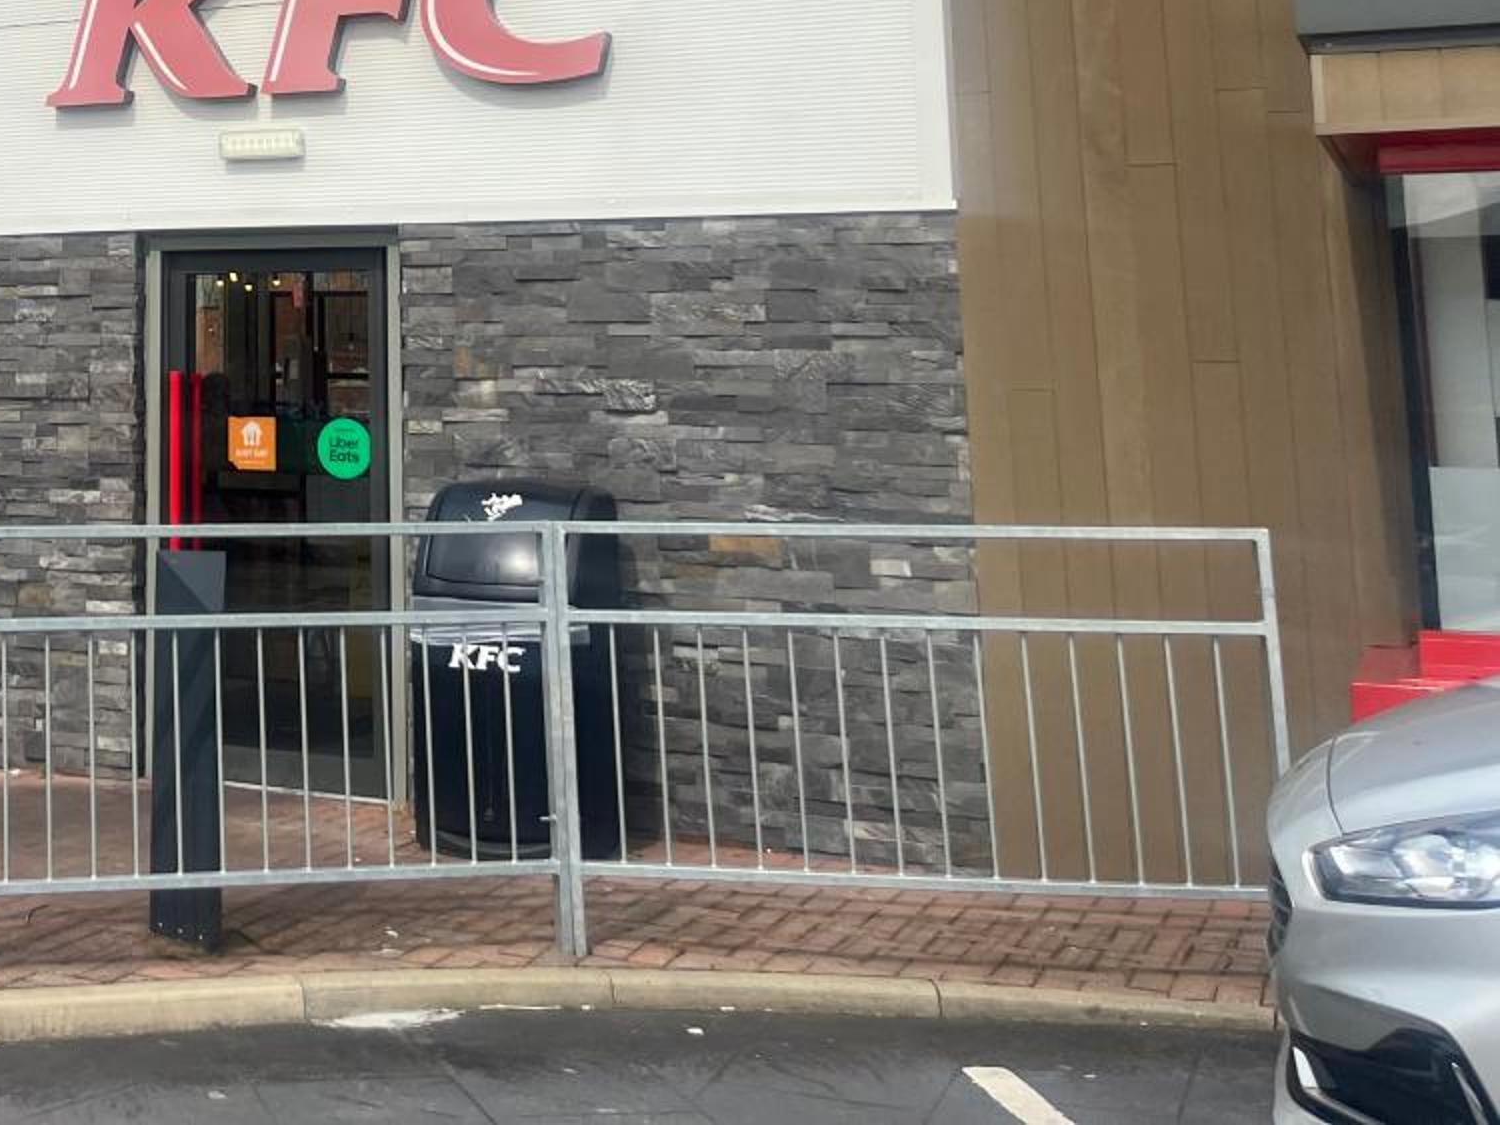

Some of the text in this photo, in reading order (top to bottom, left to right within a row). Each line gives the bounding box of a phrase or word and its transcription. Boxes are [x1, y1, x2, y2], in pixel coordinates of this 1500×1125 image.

[329, 436, 358, 449] Uber
[329, 449, 360, 463] Eats
[448, 642, 526, 673] KFC
